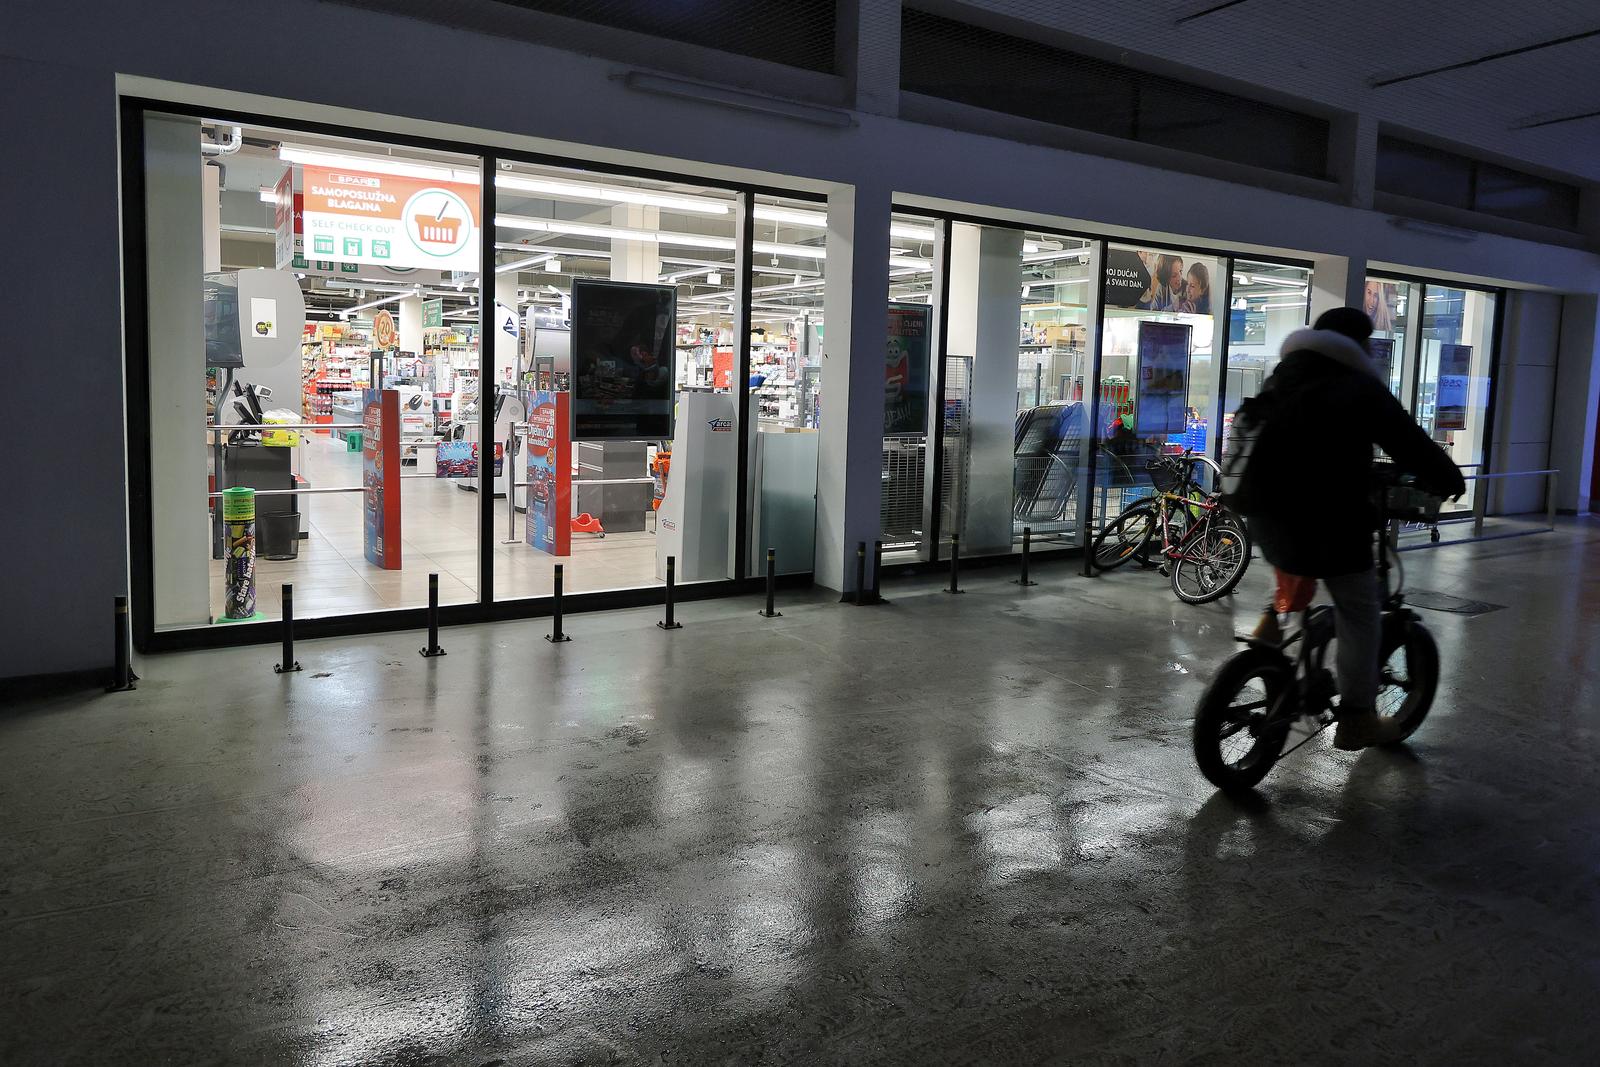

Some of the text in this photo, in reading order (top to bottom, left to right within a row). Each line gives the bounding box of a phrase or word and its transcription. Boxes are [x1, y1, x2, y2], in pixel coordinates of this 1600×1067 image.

[338, 175, 368, 184] SPAR
[311, 186, 396, 203] SAMOPOSLUŽNA
[328, 199, 381, 212] BLAGAJNA
[311, 219, 396, 234] SELF CHECK OUT
[1117, 268, 1138, 278] DUĆAN
[1111, 278, 1128, 287] SVAKI
[236, 580, 250, 603] Stare
